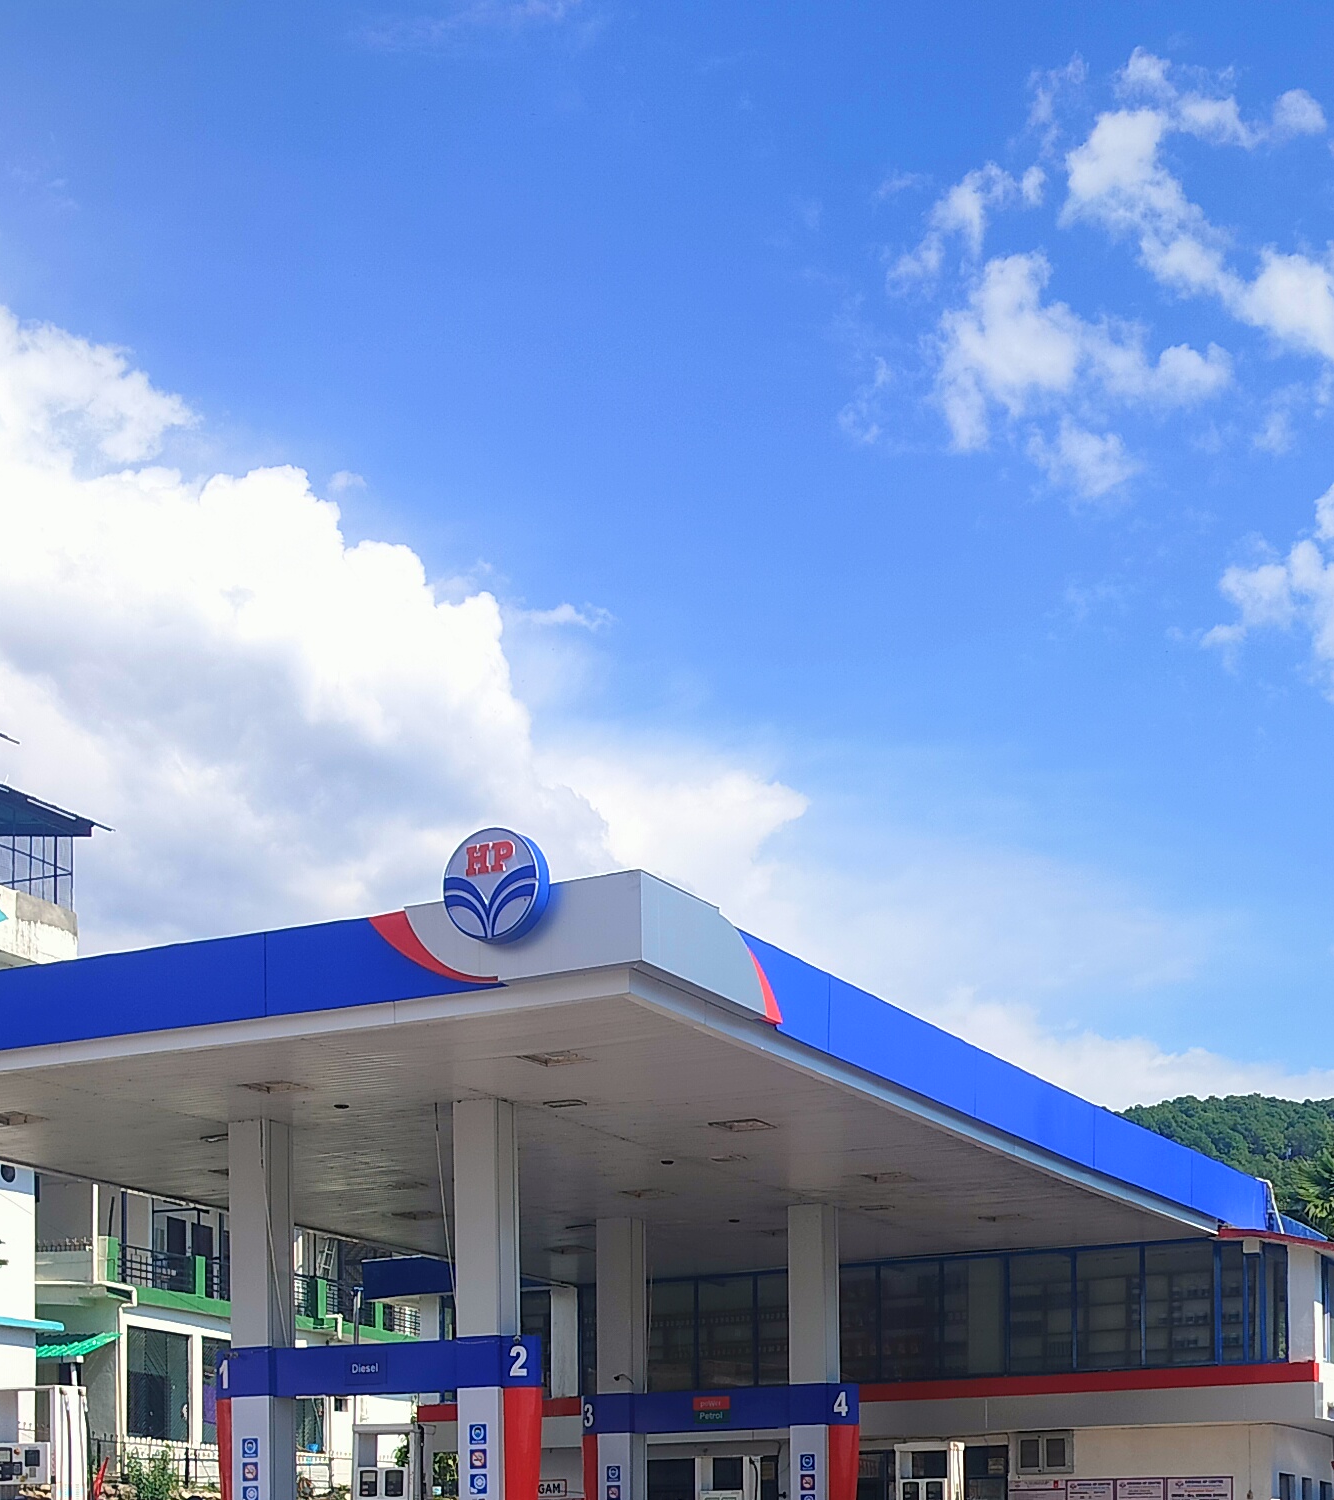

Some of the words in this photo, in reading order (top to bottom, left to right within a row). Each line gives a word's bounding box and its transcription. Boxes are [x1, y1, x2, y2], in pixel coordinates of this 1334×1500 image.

[466, 840, 515, 877] HP
[219, 1359, 228, 1389] 1
[351, 1362, 379, 1375] Diesel
[509, 1345, 528, 1377] 2
[584, 1404, 594, 1427] 3
[699, 1411, 723, 1420] Petrol
[833, 1391, 848, 1417] 4
